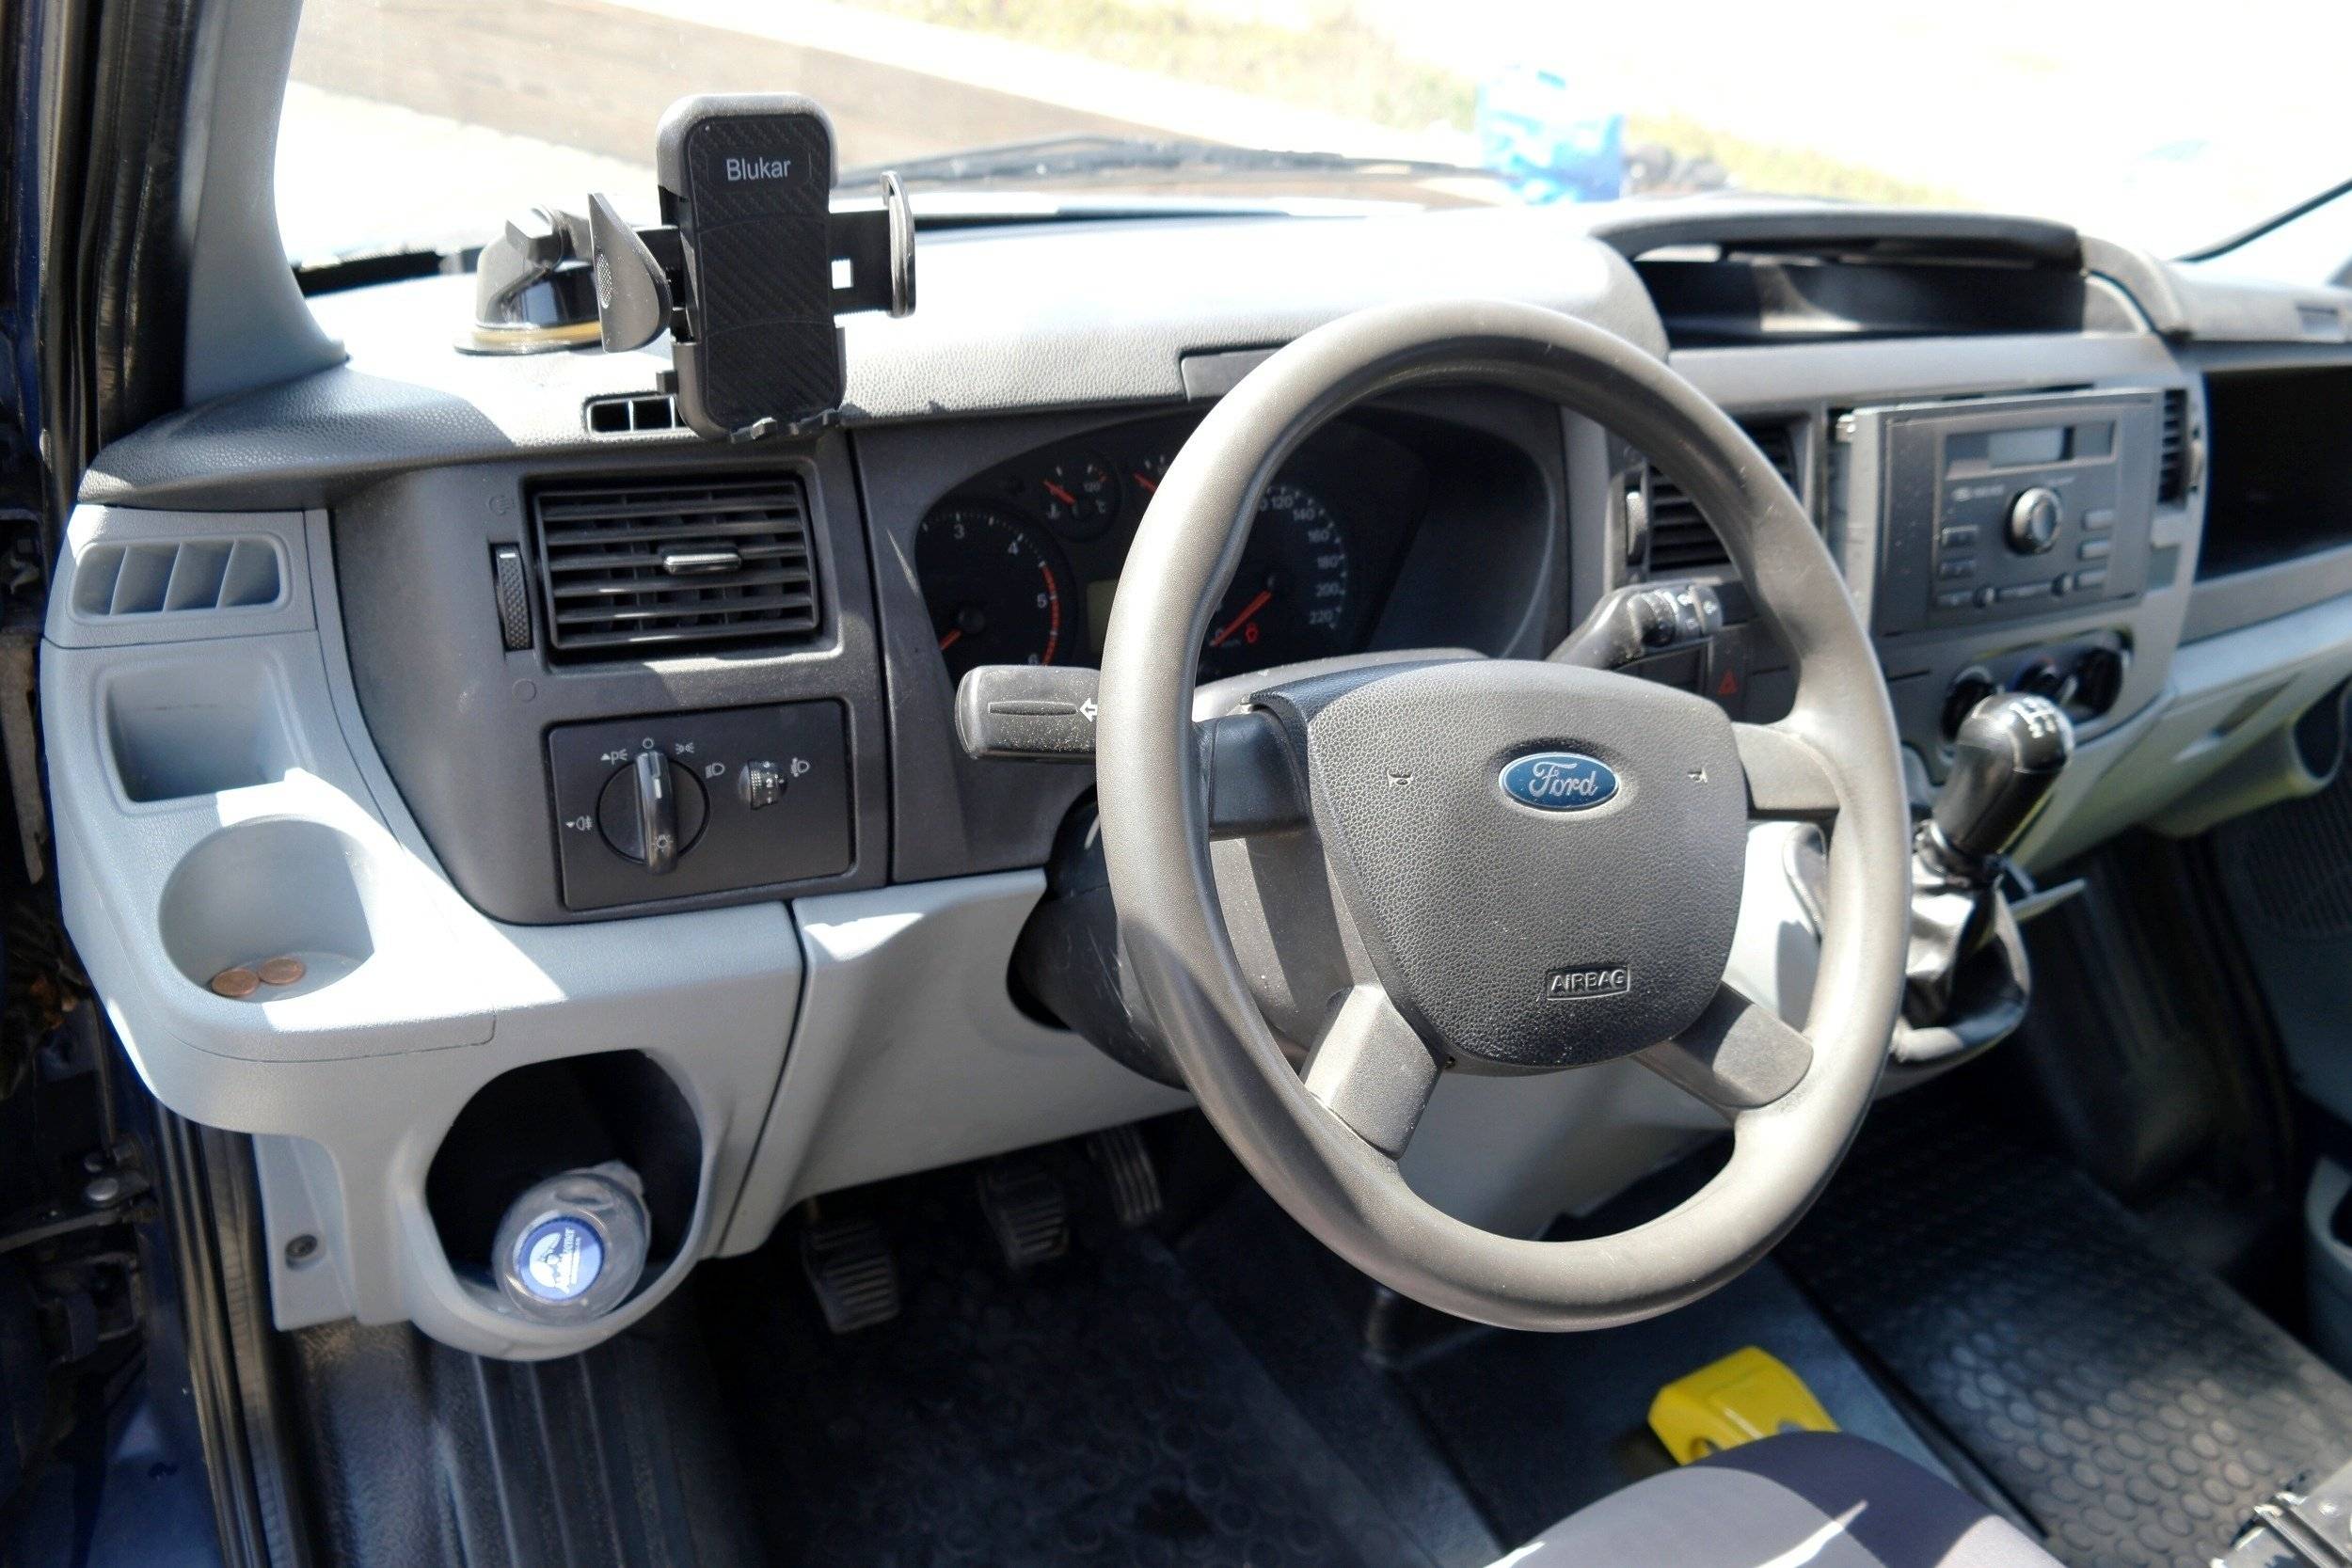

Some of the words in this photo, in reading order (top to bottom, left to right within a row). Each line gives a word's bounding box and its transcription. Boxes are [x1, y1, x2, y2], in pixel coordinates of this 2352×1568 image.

[726, 157, 790, 181] Blukar
[1271, 495, 1294, 509] 120
[953, 524, 965, 540] 3
[1008, 542, 1019, 556] 4
[1037, 594, 1047, 609] 5
[1529, 761, 1598, 798] Ford
[1551, 969, 1626, 991] AIRBAG
